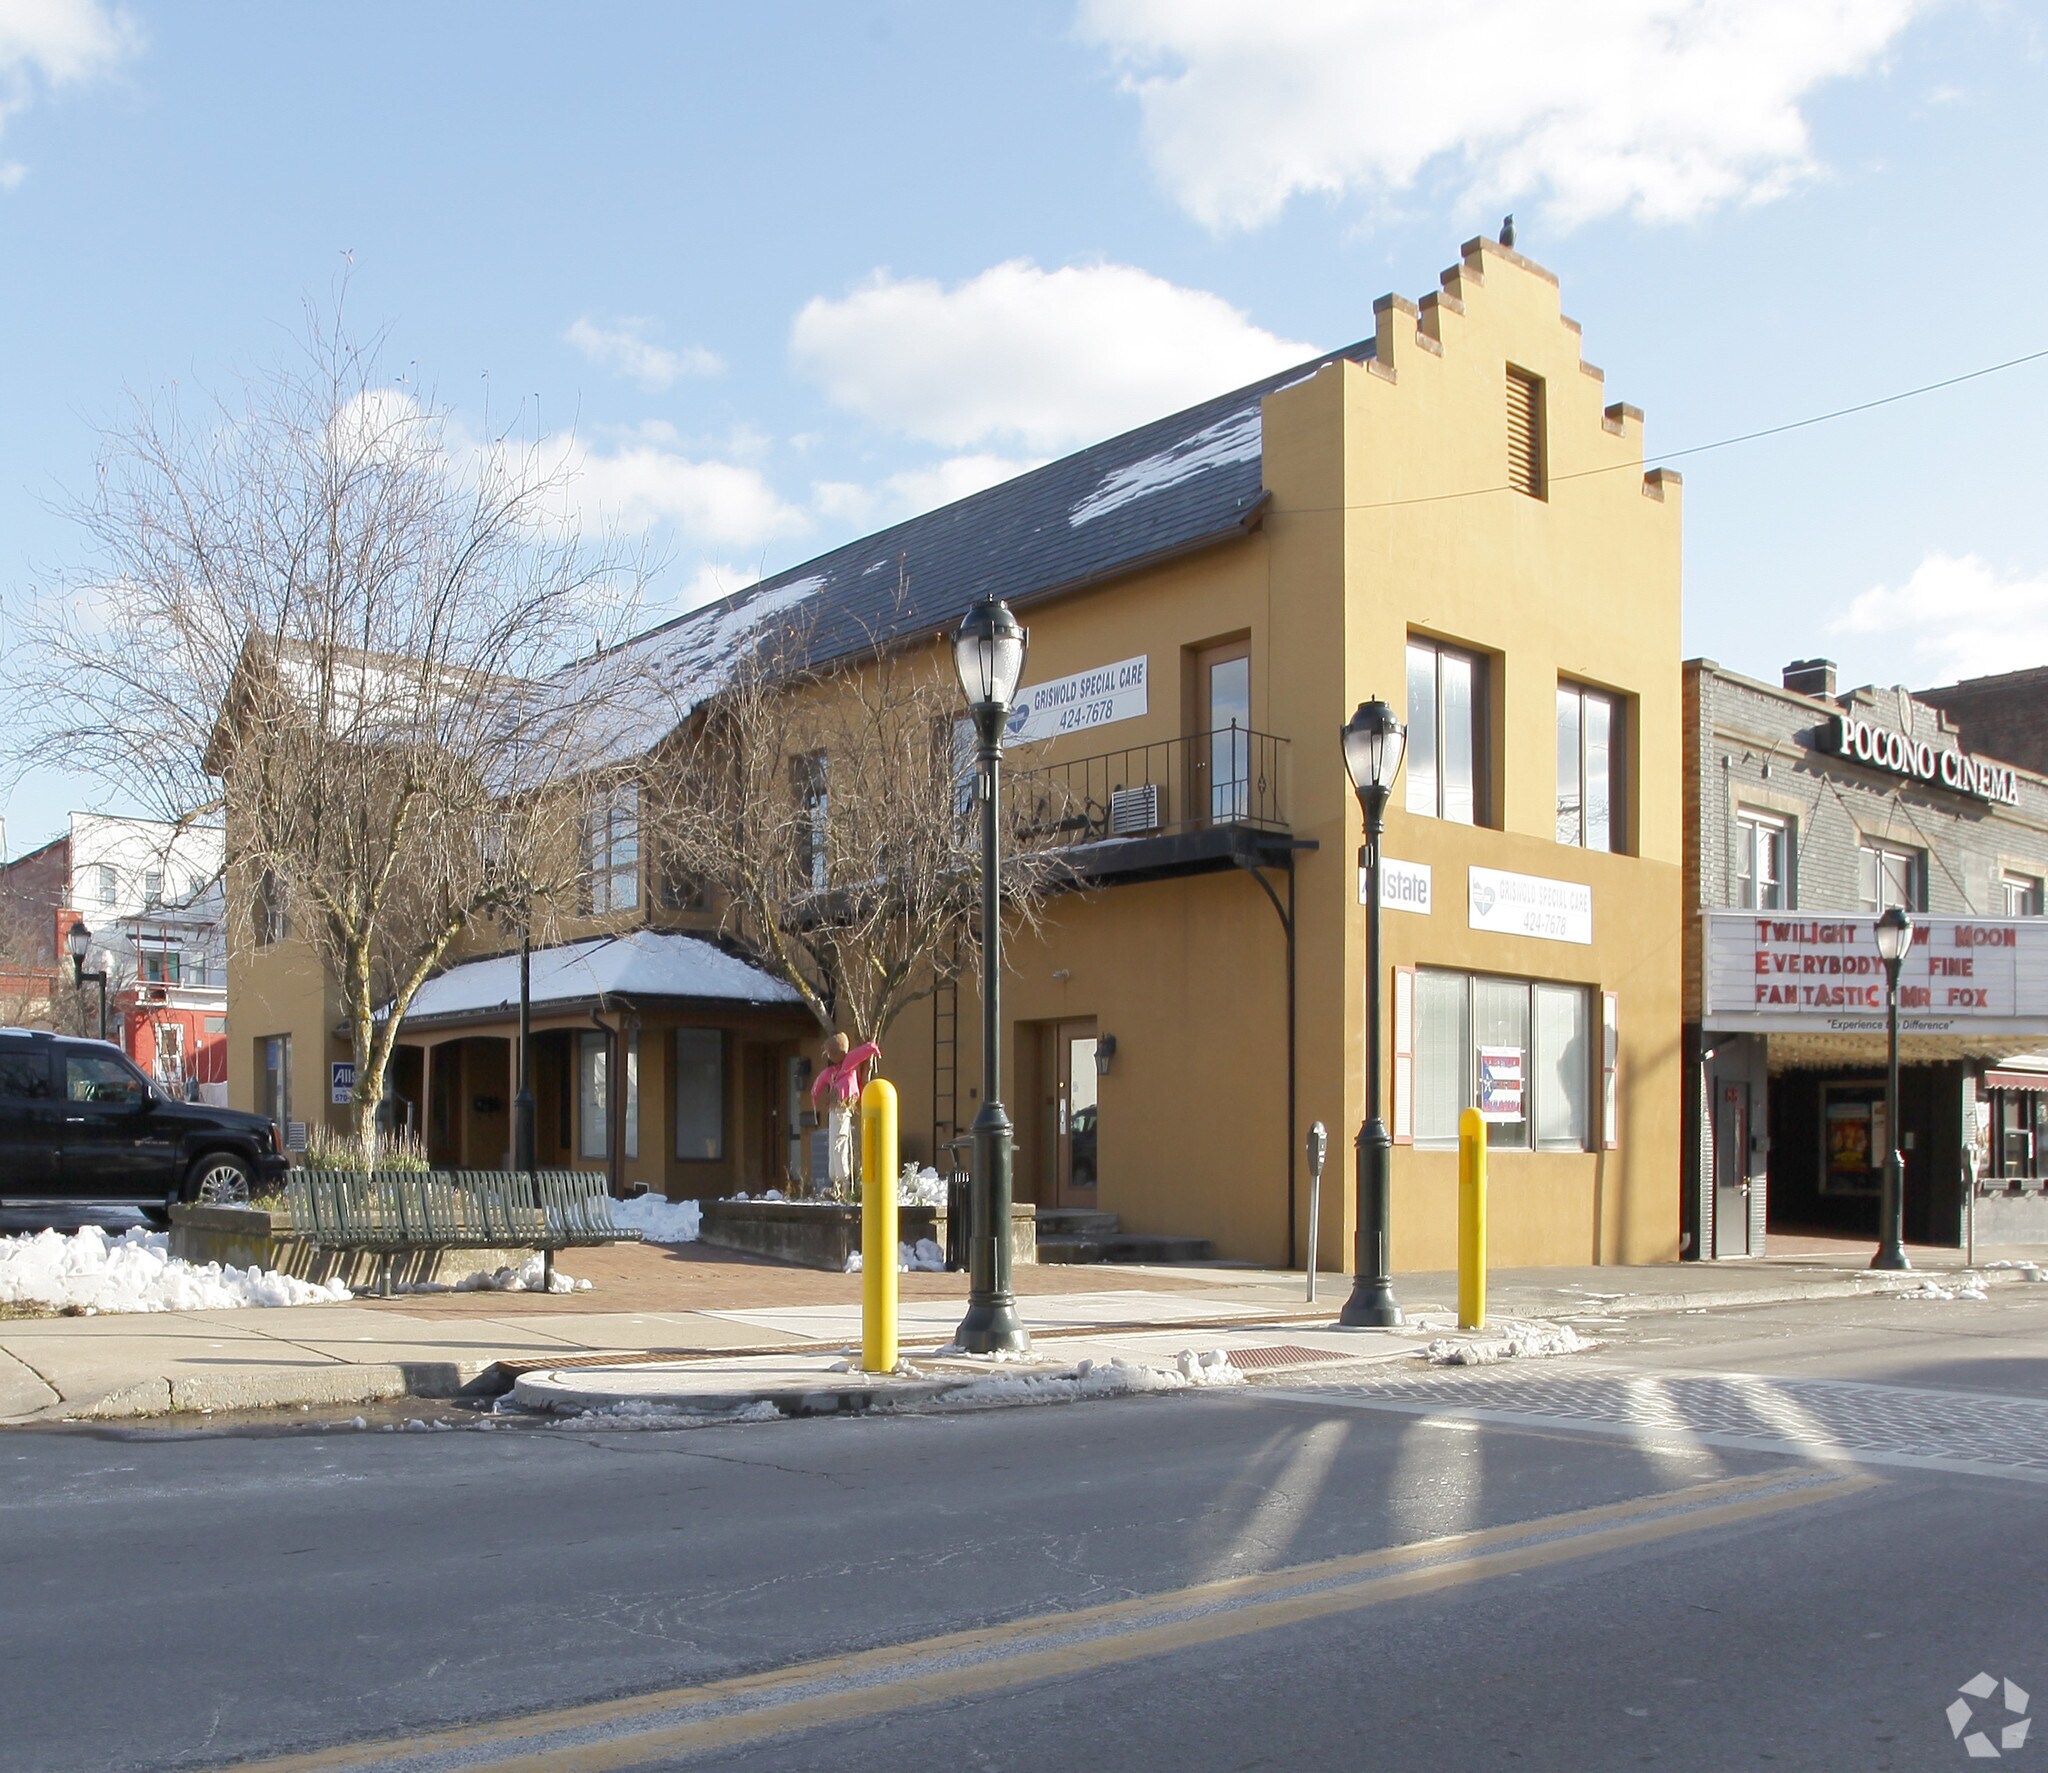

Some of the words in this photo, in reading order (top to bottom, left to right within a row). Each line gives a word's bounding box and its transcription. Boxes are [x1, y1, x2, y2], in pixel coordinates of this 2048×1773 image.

[1034, 681, 1077, 710] GRISWOLD
[1080, 671, 1115, 699] SPECIAL
[1119, 663, 1144, 689] CARE
[1060, 699, 1113, 729] 424-7678
[1839, 715, 1935, 779] POCONO
[1940, 749, 2020, 806] CINEMA
[1361, 868, 1427, 904] lstate
[1500, 879, 1536, 904] GRISWOLD
[1539, 885, 1567, 910] SPECIAL
[1570, 891, 1588, 913] CARE
[1523, 911, 1567, 936] 424-7678
[1757, 920, 1857, 944] TWILIGHT
[1954, 925, 2016, 948] MOON
[1929, 956, 1974, 977] FINE
[1756, 984, 1880, 1007] FANTASTIC
[1900, 985, 1931, 1008] MR
[1947, 987, 1989, 1008] FOX
